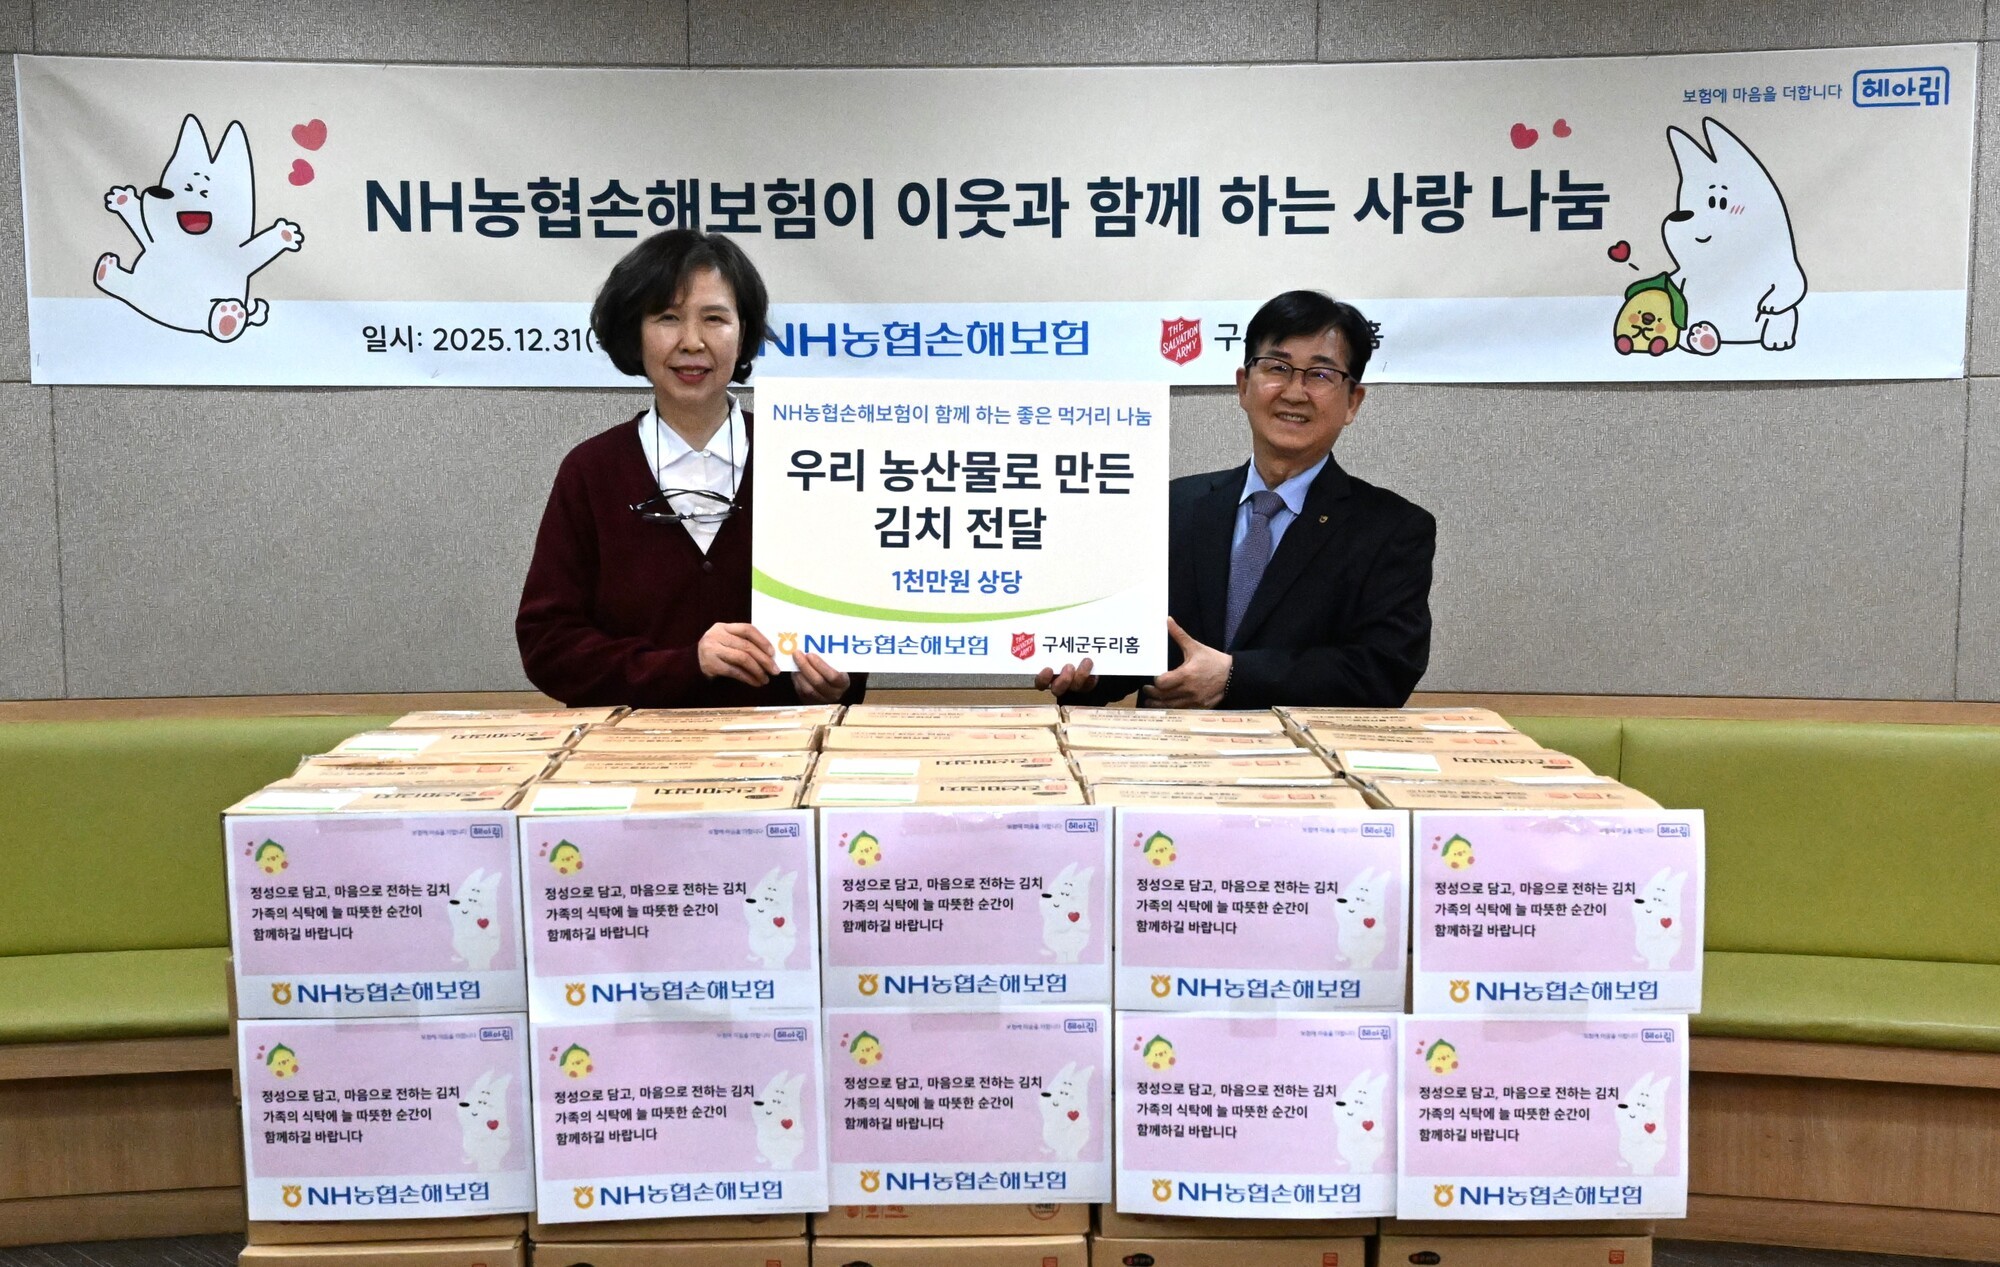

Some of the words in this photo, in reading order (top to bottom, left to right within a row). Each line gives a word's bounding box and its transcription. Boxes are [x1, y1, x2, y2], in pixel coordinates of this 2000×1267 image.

[1682, 88, 1727, 104] 보험에
[1732, 86, 1777, 103] 마음을
[1782, 84, 1842, 101] 더합니다
[1861, 76, 1941, 106] 헤아림
[366, 177, 874, 239] NH농협손해보험이
[898, 177, 1069, 239] 이웃과
[1087, 176, 1199, 237] 함께
[1220, 175, 1335, 236] 하는
[1353, 171, 1473, 234] 사랑
[1492, 170, 1610, 232] 나눔
[1168, 321, 1184, 337] THE
[362, 325, 423, 353] 일시:
[433, 328, 601, 353] 2025.12.31(
[1162, 323, 1198, 354] SALVATION
[1176, 338, 1198, 360] ARMY
[773, 403, 929, 423] NH농협손해보험이
[935, 405, 970, 424] 함께
[976, 405, 1011, 424] 하는
[1017, 406, 1052, 425] 좋은
[1058, 406, 1110, 426] 먹거리
[1117, 406, 1152, 426] 나눔
[787, 449, 865, 492] 우리
[880, 450, 1042, 493] 농산물로
[1055, 451, 1135, 494] 만든
[875, 506, 951, 549] 김치
[967, 507, 1047, 550] 전달
[892, 569, 970, 594] 1천만원
[978, 570, 1022, 594] 상당
[804, 634, 989, 656] NH농협손해보험
[1042, 636, 1141, 654] 구세군두리홈
[251, 886, 299, 899] 정성으로
[303, 886, 330, 899] 담고,
[335, 885, 382, 898] 마음으로
[387, 884, 422, 897] 전하는
[427, 883, 449, 896] 김치
[545, 887, 594, 900] 정성으로
[598, 885, 625, 898] 담고,
[630, 884, 679, 897] 마음으로
[683, 883, 718, 895] 전하는
[723, 882, 746, 895] 김치
[843, 879, 891, 892] 정성으로
[895, 878, 922, 891] 담고,
[927, 878, 975, 890] 마음으로
[979, 877, 1015, 890] 전하는
[1020, 877, 1042, 890] 김치
[1137, 878, 1185, 891] 정성으로
[1189, 879, 1216, 893] 담고,
[1222, 880, 1269, 893] 마음으로
[1274, 881, 1310, 893] 전하는
[1314, 881, 1337, 894] 김치
[1435, 882, 1483, 895] 정성으로
[1488, 882, 1515, 896] 담고,
[1520, 882, 1568, 895] 마음으로
[1572, 882, 1608, 895] 전하는
[1613, 882, 1635, 895] 김치
[252, 907, 287, 920] 가족의
[292, 906, 328, 920] 식탁에
[332, 906, 343, 919] 늘
[347, 905, 382, 918] 따뜻한
[387, 905, 422, 918] 순간이
[843, 900, 878, 912] 가족의
[883, 899, 918, 911] 식탁에
[923, 899, 934, 911] 늘
[938, 898, 974, 911] 따뜻한
[978, 898, 1013, 910] 순간이
[1435, 903, 1470, 916] 가족의
[1475, 903, 1511, 916] 식탁에
[1516, 904, 1527, 916] 늘
[1531, 903, 1567, 916] 따뜻한
[1571, 903, 1606, 916] 순간이
[253, 928, 300, 941] 함께하길
[305, 927, 353, 940] 바랍니다
[547, 927, 595, 942] 함께하길
[600, 926, 649, 939] 바랍니다
[843, 920, 890, 933] 함께하길
[895, 919, 943, 932] 바랍니다
[1136, 920, 1184, 933] 함께하길
[1189, 921, 1237, 934] 바랍니다
[1435, 924, 1483, 937] 함께하길
[1487, 924, 1536, 937] 바랍니다
[298, 980, 480, 1003] NH농협손해보험
[592, 980, 774, 1003] NH농협손해보험
[885, 974, 1066, 994] NH농협손해보험
[1178, 978, 1360, 999] NH농협손해보험
[1477, 981, 1657, 1001] NH농협손해보험
[845, 1077, 892, 1090] 정성으로
[896, 1077, 922, 1090] 담고,
[928, 1077, 975, 1089] 마음으로
[980, 1076, 1014, 1089] 전하는
[1019, 1076, 1041, 1089] 김치
[1137, 1082, 1184, 1095] 정성으로
[1189, 1083, 1215, 1097] 담고,
[1221, 1084, 1269, 1097] 마음으로
[1273, 1084, 1309, 1097] 전하는
[1314, 1085, 1337, 1098] 김치
[262, 1090, 309, 1103] 정성으로
[313, 1089, 340, 1103] 담고,
[344, 1089, 392, 1101] 마음으로
[396, 1088, 432, 1100] 전하는
[437, 1086, 460, 1099] 김치
[555, 1090, 603, 1104] 정성으로
[608, 1088, 634, 1101] 담고,
[640, 1086, 688, 1099] 마음으로
[692, 1085, 727, 1098] 전하는
[731, 1085, 754, 1097] 김치
[1420, 1086, 1467, 1099] 정성으로
[1471, 1087, 1498, 1100] 담고,
[1503, 1086, 1551, 1099] 마음으로
[1556, 1087, 1591, 1099] 전하는
[1596, 1087, 1618, 1100] 김치
[844, 1097, 879, 1110] 가족의
[884, 1097, 919, 1110] 식탁에
[924, 1097, 934, 1109] 늘
[939, 1097, 974, 1109] 따뜻한
[978, 1096, 1013, 1109] 순간이
[264, 1110, 298, 1123] 가족의
[303, 1110, 337, 1122] 식탁에
[342, 1110, 352, 1122] 늘
[357, 1109, 392, 1122] 따뜻한
[396, 1108, 431, 1121] 순간이
[1419, 1108, 1454, 1120] 가족의
[1459, 1107, 1494, 1120] 식탁에
[1499, 1108, 1510, 1120] 늘
[1514, 1108, 1550, 1120] 따뜻한
[1554, 1108, 1589, 1120] 순간이
[845, 1117, 892, 1130] 함께하길
[896, 1117, 944, 1130] 바랍니다
[264, 1131, 311, 1144] 함께하길
[315, 1130, 363, 1143] 바랍니다
[1419, 1129, 1466, 1142] 함께하길
[1471, 1129, 1519, 1142] 바랍니다
[887, 1171, 1066, 1190] NH농협손해보험
[308, 1182, 489, 1205] NH농협손해보험
[601, 1181, 782, 1205] NH농협손해보험
[1179, 1182, 1360, 1203] NH농협손해보험
[1460, 1186, 1641, 1206] NH농협손해보험
